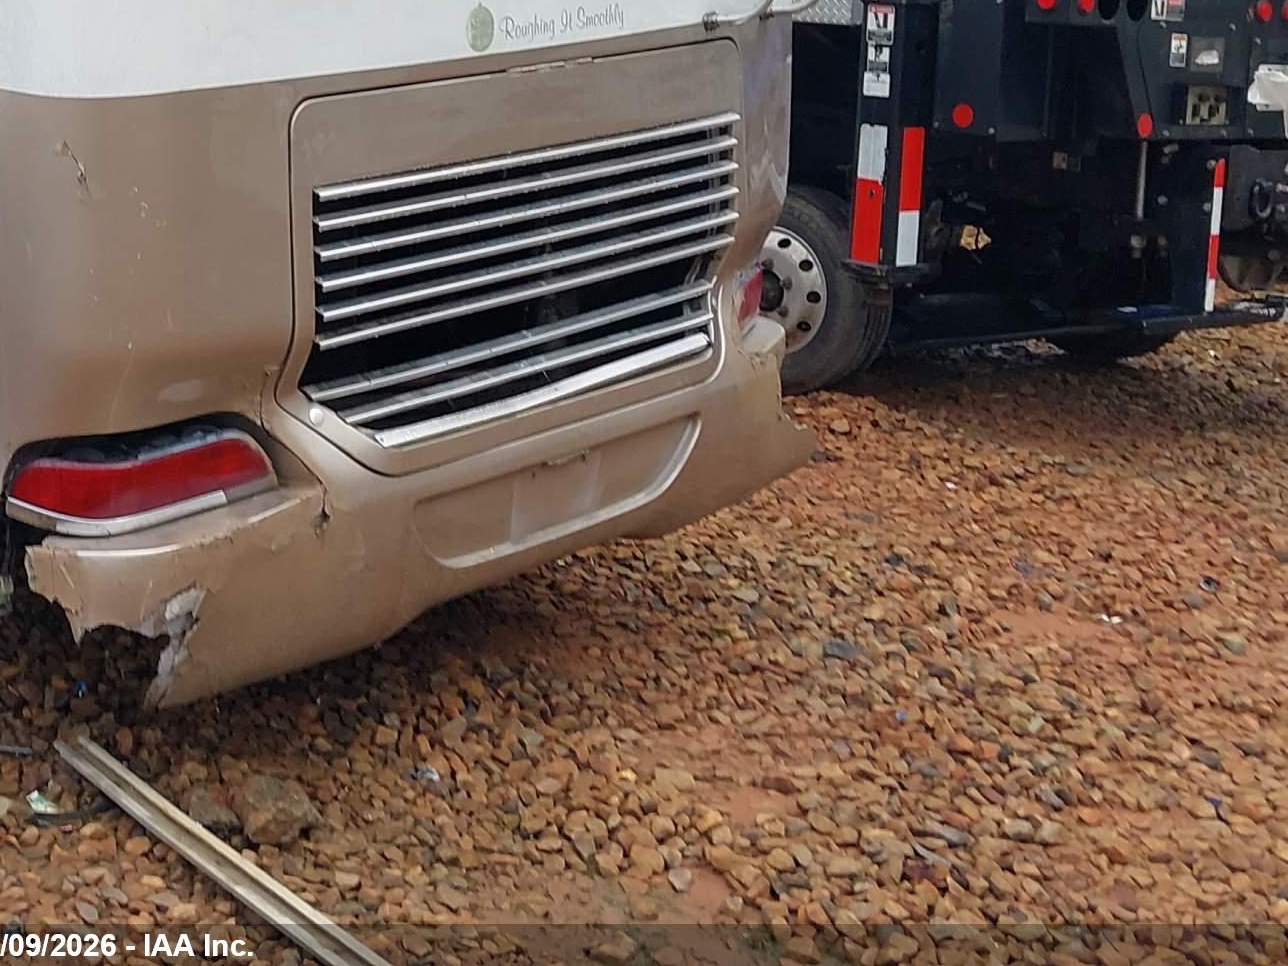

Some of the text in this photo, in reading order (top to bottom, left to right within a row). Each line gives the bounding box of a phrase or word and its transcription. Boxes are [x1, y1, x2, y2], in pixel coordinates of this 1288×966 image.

[499, 2, 625, 41] Roughing It Smoothly
